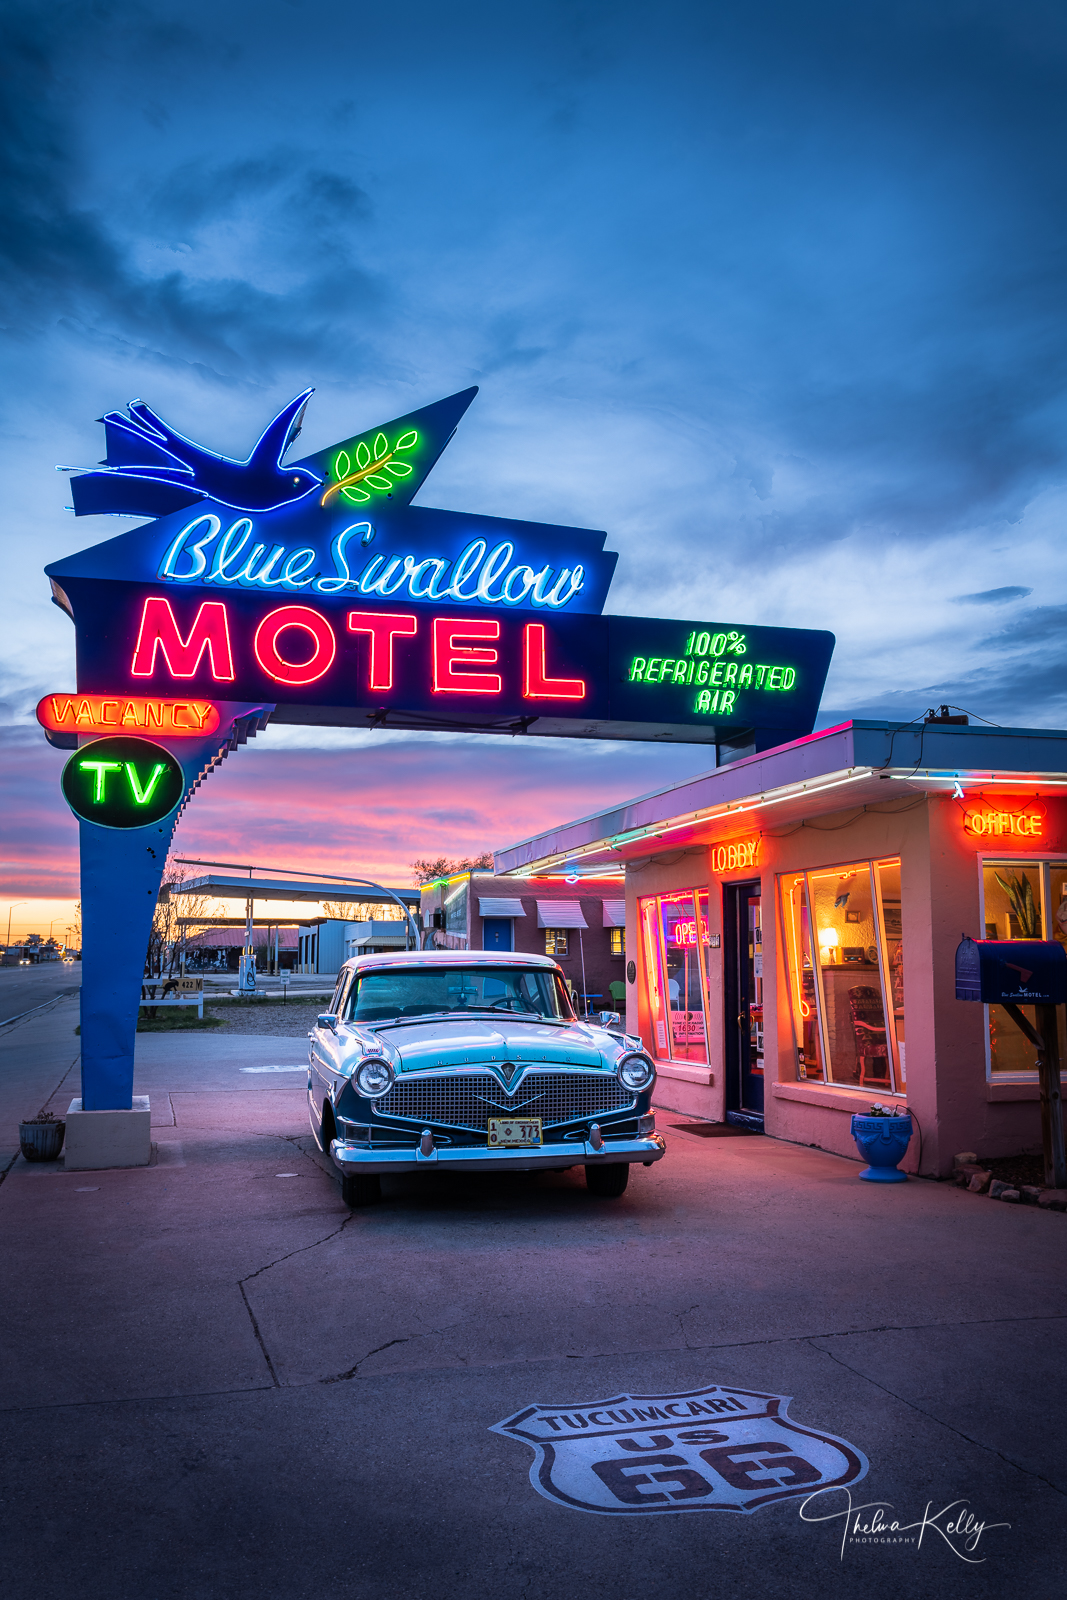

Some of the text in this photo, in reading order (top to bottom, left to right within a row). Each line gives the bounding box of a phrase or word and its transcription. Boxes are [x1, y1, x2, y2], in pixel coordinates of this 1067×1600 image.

[157, 513, 585, 609] Blue Swallow
[131, 597, 585, 699] MOTEL
[685, 631, 746, 656] 100%
[629, 657, 796, 691] REFRIGERATED
[52, 697, 212, 729] VACANCY
[694, 690, 735, 715] AIR
[79, 760, 167, 806] TV
[967, 811, 1042, 837] OFFICE
[712, 841, 758, 872] LOBBY
[182, 981, 194, 989] 422
[678, 1024, 696, 1032] 1630
[519, 1125, 540, 1139] 373
[537, 1397, 748, 1432] TUCUMCARI
[616, 1429, 729, 1452] US
[590, 1442, 824, 1504] 66
